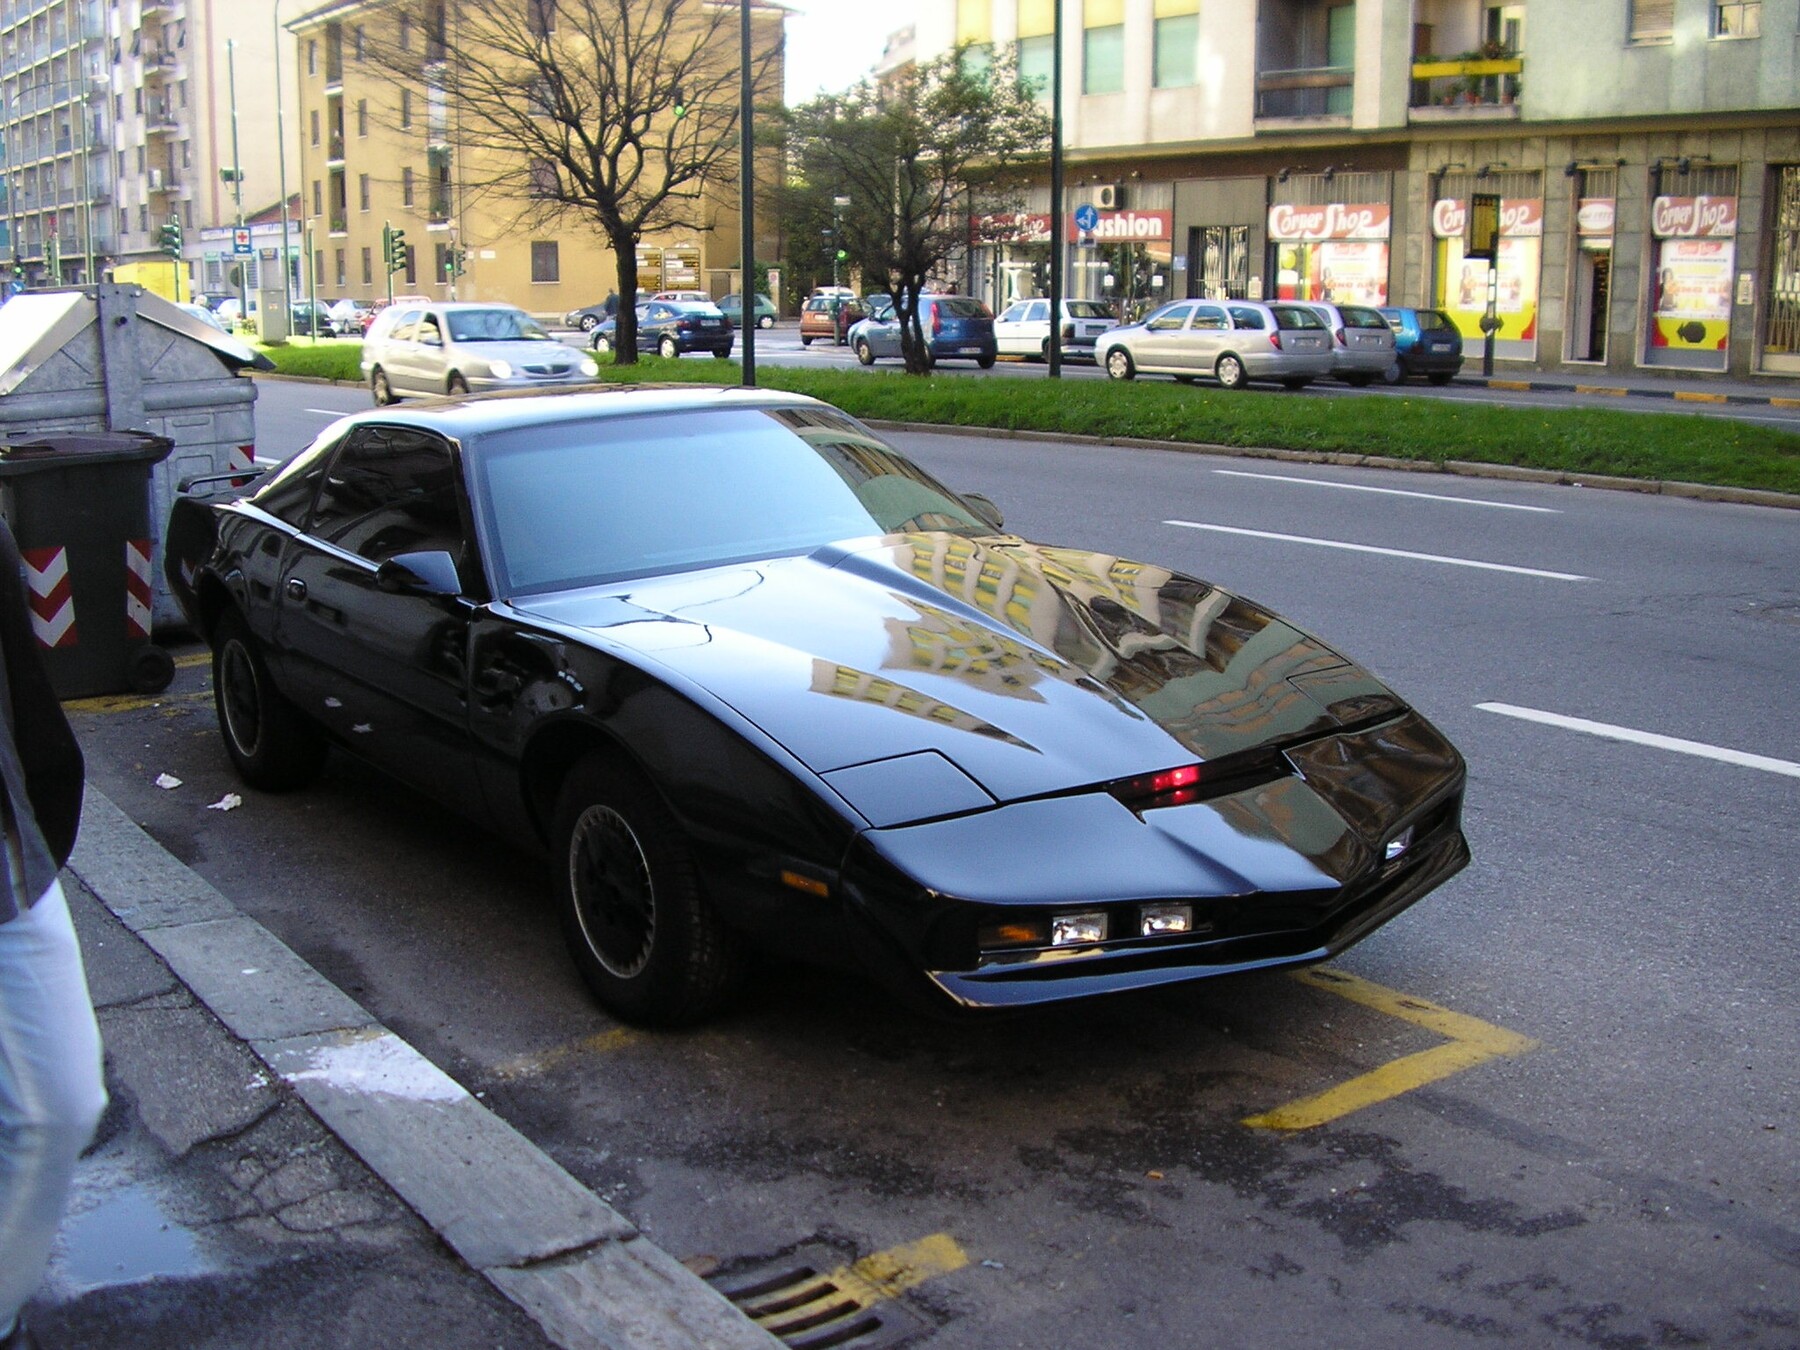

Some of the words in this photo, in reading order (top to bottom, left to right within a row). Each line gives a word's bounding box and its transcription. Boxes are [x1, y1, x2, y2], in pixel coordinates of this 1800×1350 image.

[1079, 213, 1162, 237] ashion
[1269, 205, 1323, 238] Corner
[1306, 204, 1373, 238] Shop
[1653, 196, 1693, 236] Corner
[1682, 196, 1728, 236] Shop
